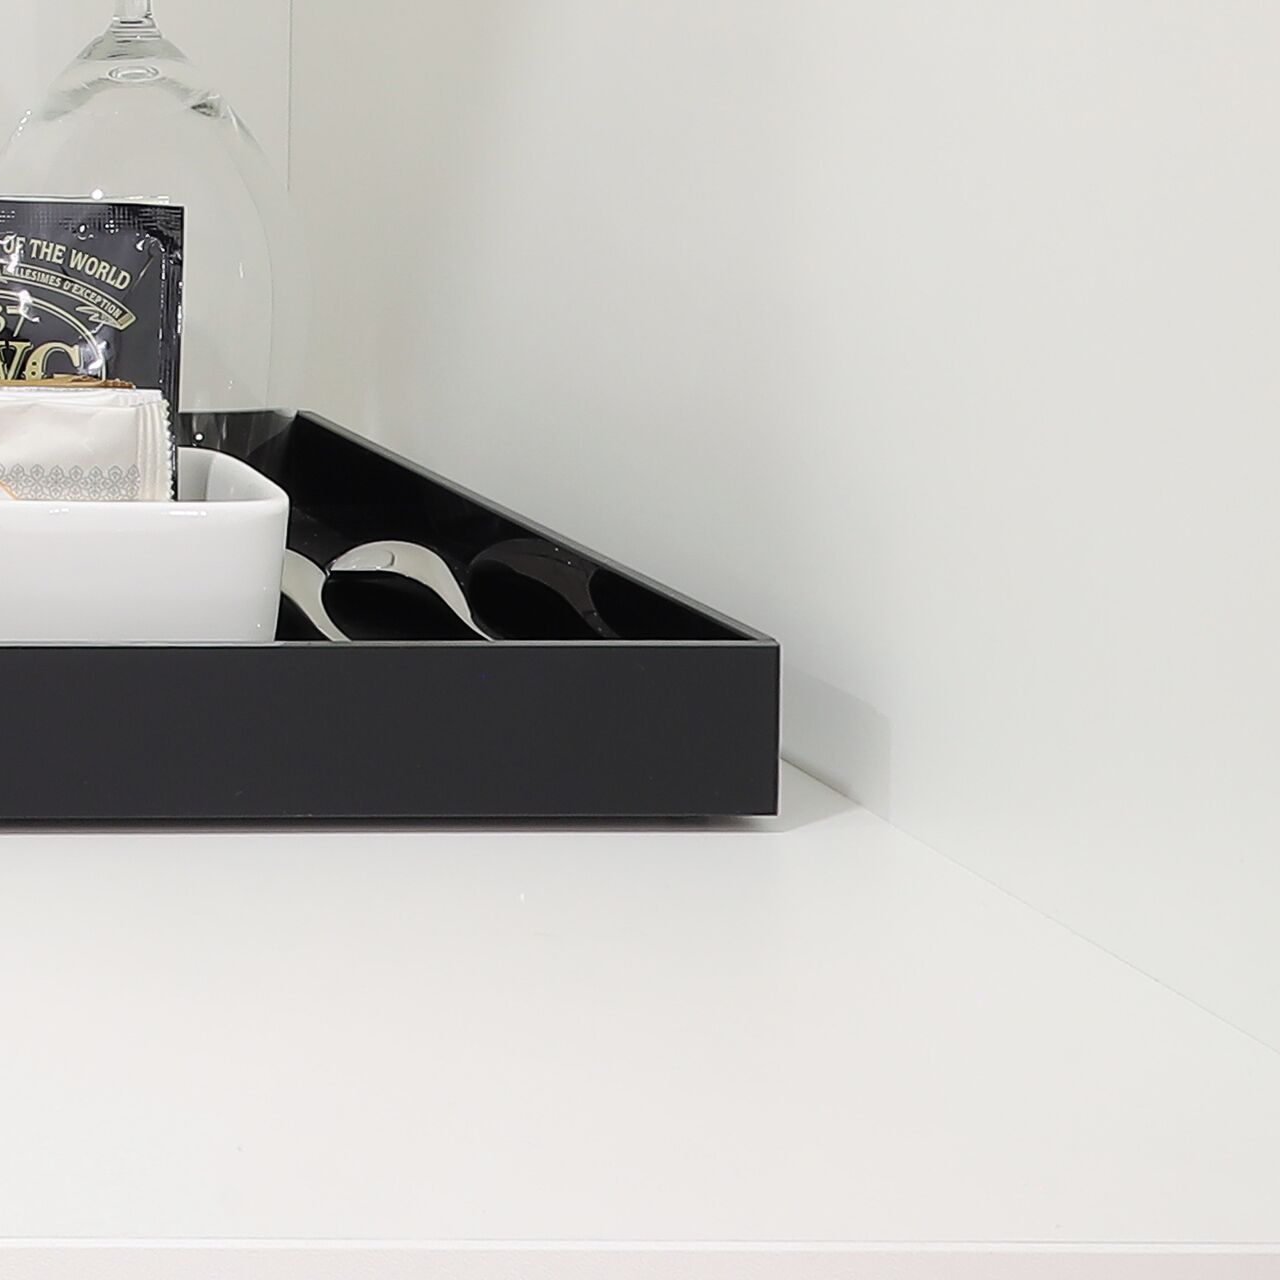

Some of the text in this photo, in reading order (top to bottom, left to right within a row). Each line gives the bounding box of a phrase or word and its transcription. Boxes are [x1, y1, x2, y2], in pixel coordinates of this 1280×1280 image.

[2, 234, 25, 255] OF
[29, 239, 66, 265] THE
[69, 249, 131, 290] WORLD
[63, 280, 123, 319] D'EXCEPTION
